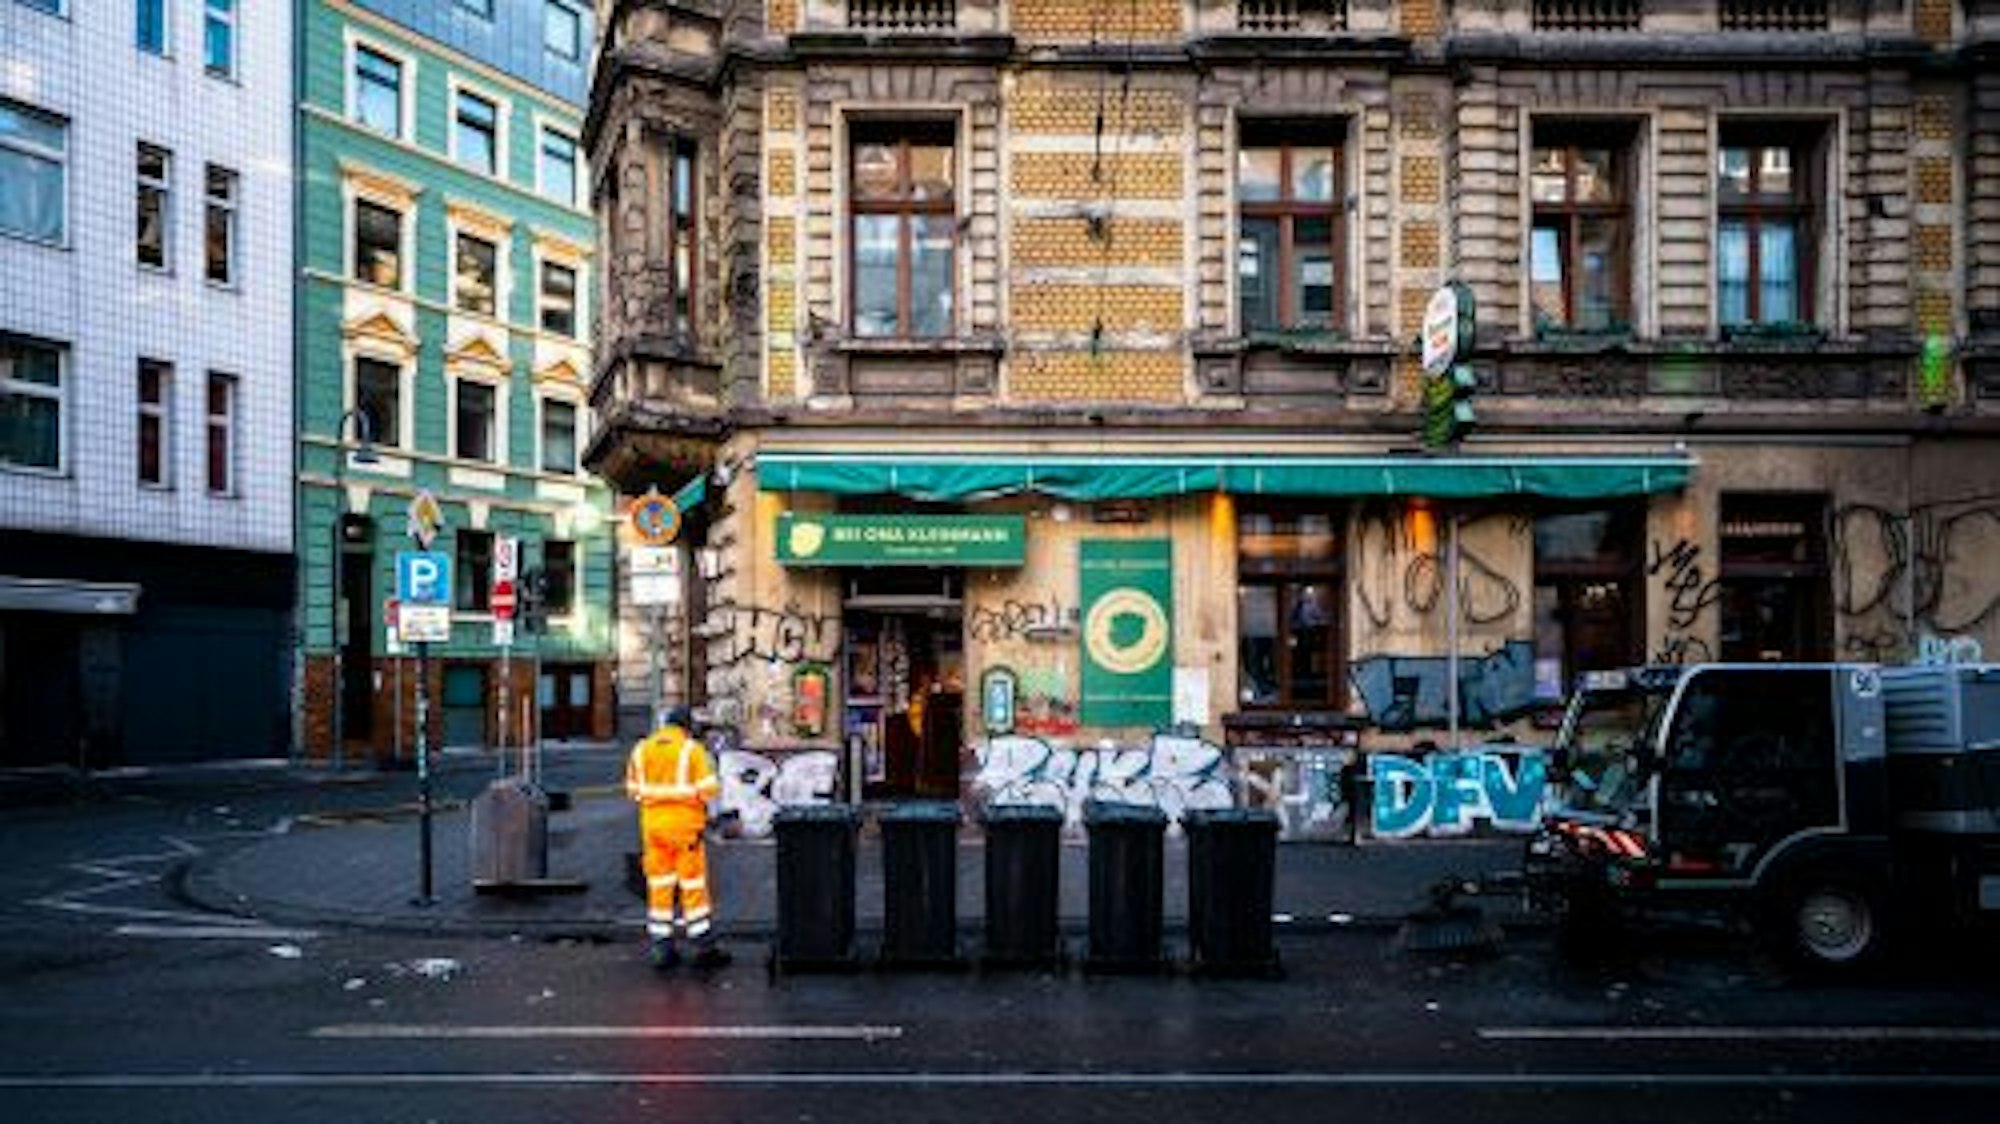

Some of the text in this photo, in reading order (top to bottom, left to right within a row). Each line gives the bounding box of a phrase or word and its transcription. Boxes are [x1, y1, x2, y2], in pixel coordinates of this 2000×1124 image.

[864, 526, 905, 542] OMA
[410, 558, 438, 597] P
[1367, 752, 1545, 836] DFV
